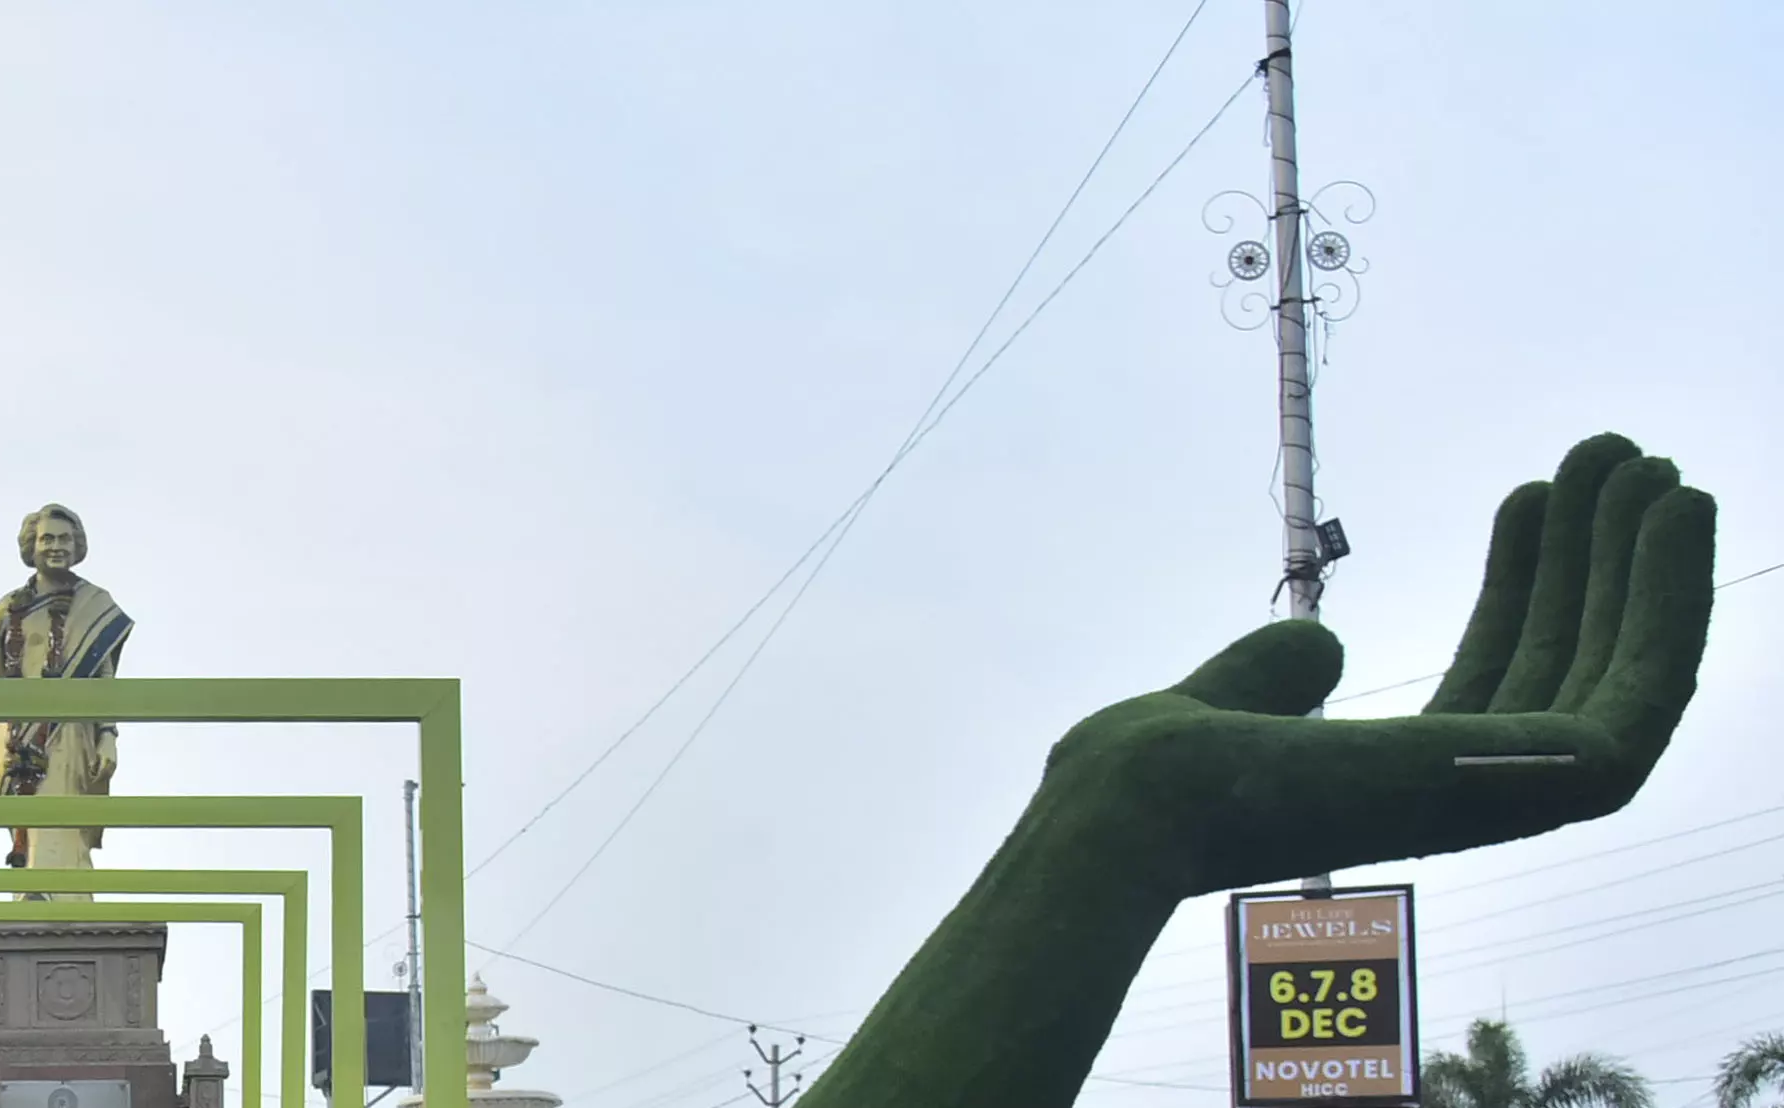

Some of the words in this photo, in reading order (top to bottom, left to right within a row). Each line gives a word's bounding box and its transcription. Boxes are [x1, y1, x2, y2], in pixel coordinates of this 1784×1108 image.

[1253, 919, 1393, 941] JEWELS
[1269, 967, 1378, 1004] 6.7.8
[1280, 1007, 1367, 1039] DEC
[1255, 1058, 1395, 1081] NOVOTEL
[1300, 1082, 1349, 1097] HICC
